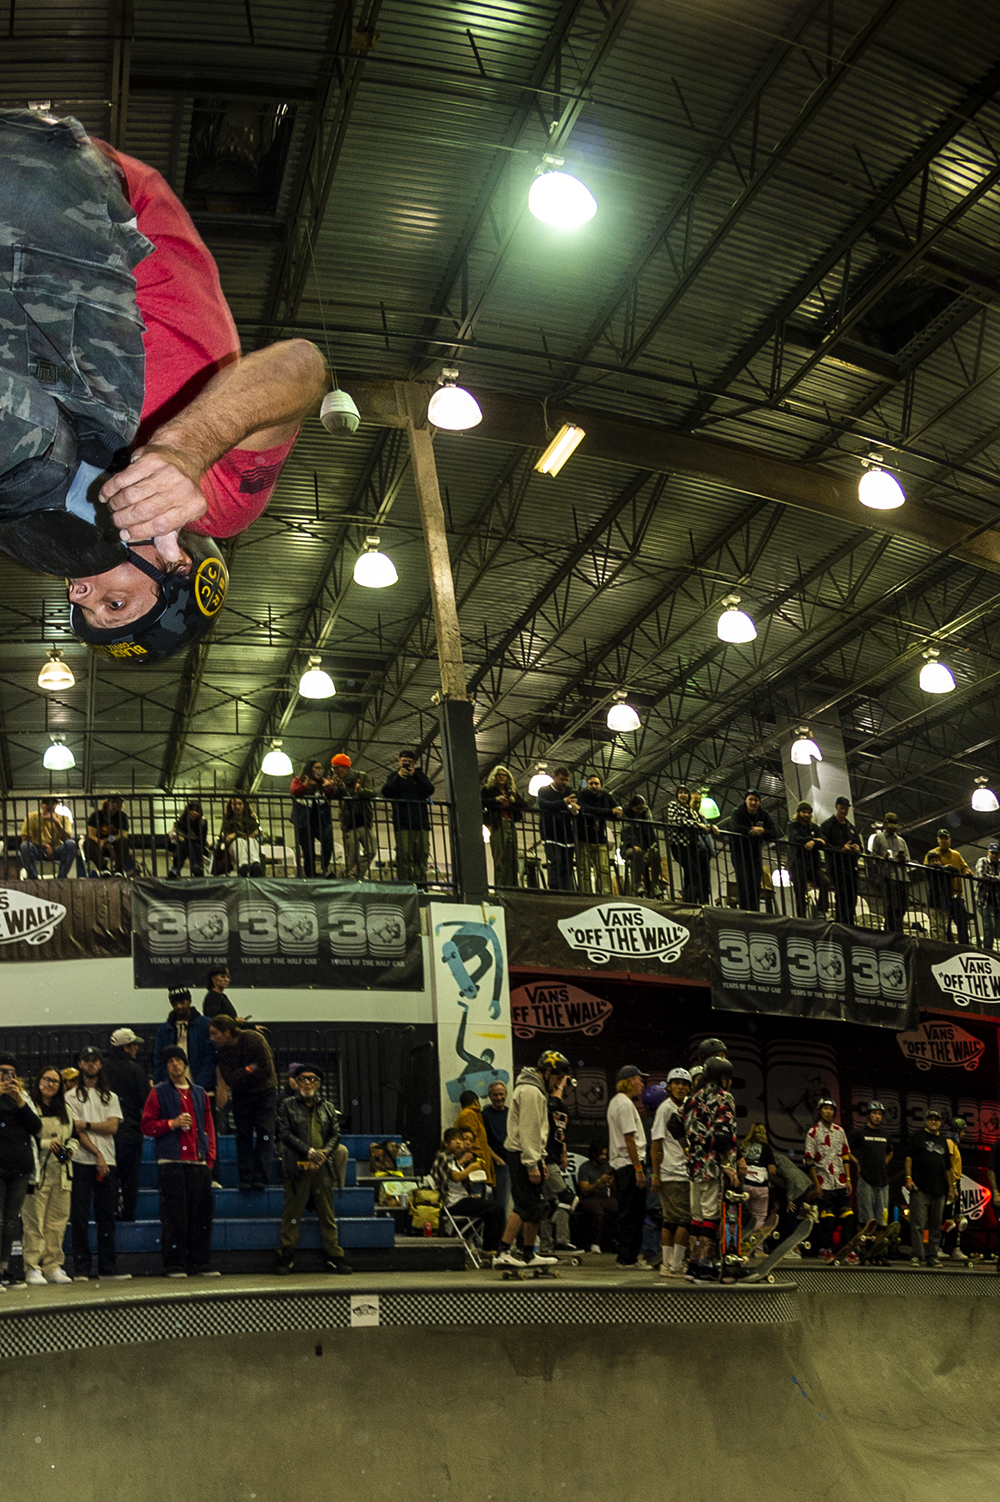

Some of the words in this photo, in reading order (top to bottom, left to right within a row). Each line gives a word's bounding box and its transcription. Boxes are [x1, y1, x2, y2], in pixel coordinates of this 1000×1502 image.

[605, 928, 640, 952] THE
[149, 956, 170, 964] YEARS
[722, 982, 739, 990] YEARS
[747, 984, 757, 992] THE
[965, 975, 990, 998] THE
[530, 1005, 566, 1027] THE
[928, 1040, 950, 1061] THE
